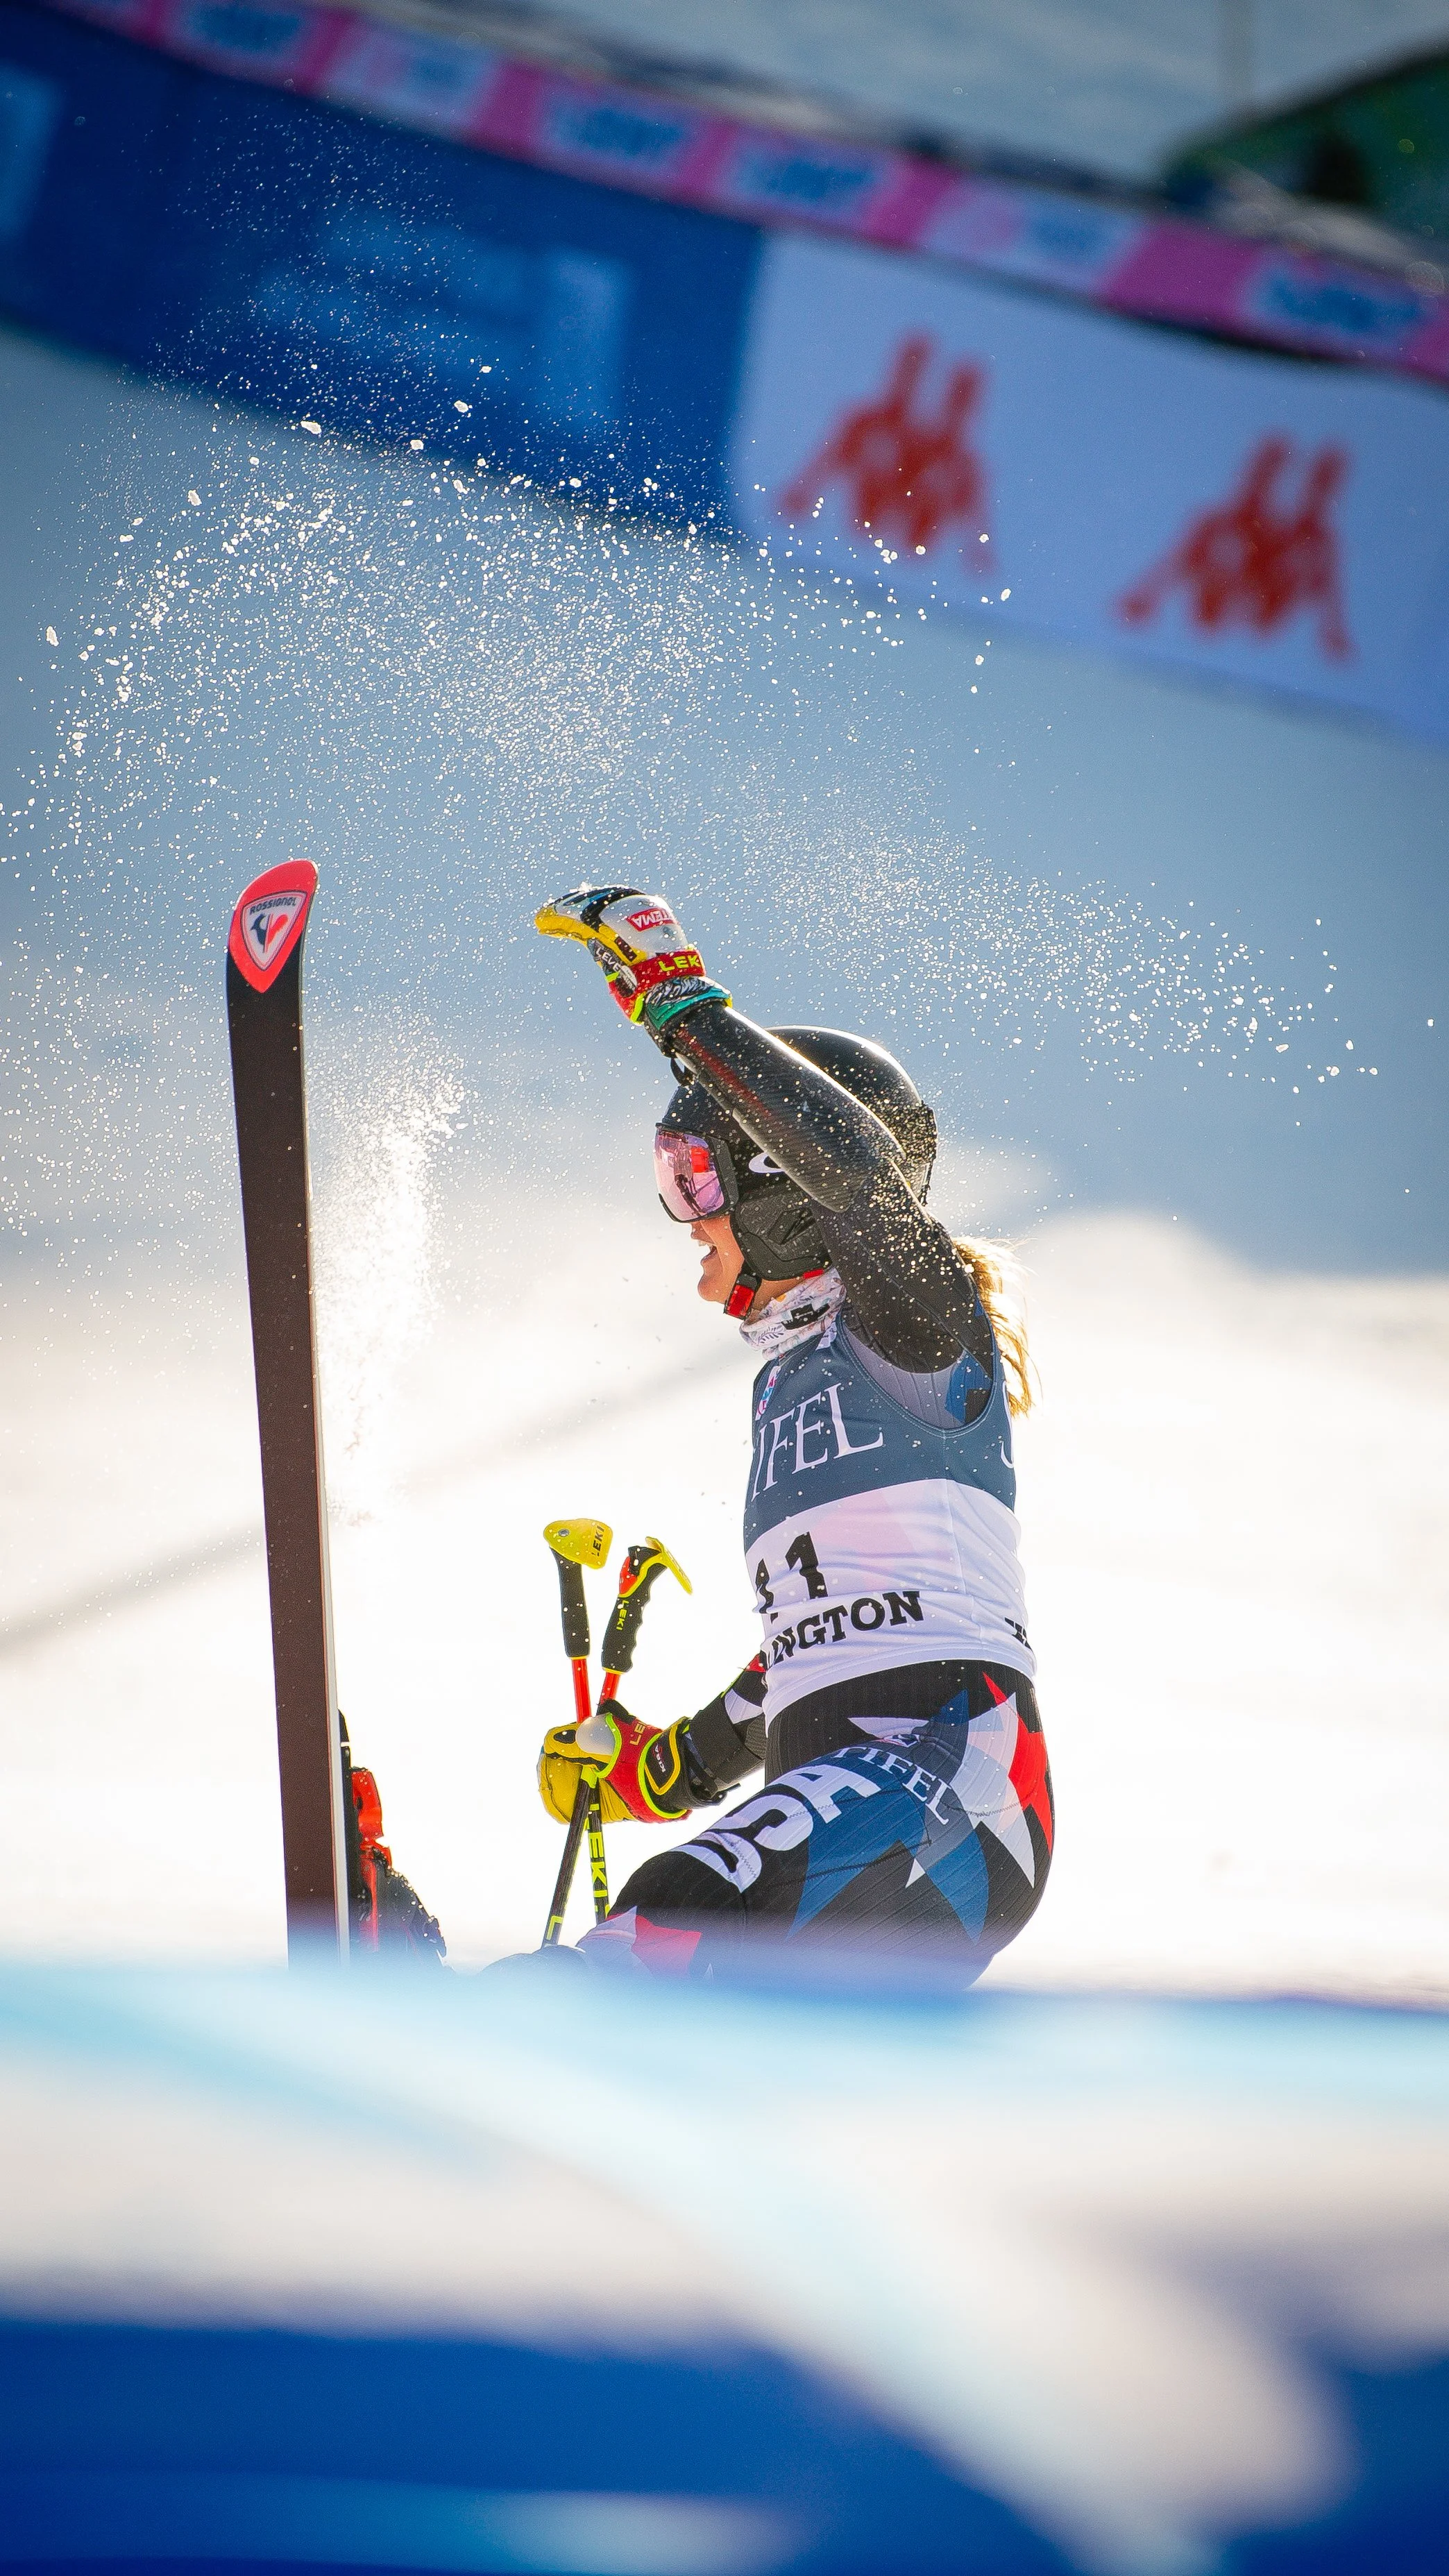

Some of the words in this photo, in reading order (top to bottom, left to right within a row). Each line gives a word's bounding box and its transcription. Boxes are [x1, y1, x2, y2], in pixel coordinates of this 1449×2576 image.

[250, 897, 296, 915] ROSSIGNOL
[616, 1600, 629, 1630] LEKI
[669, 1765, 882, 1893] USA
